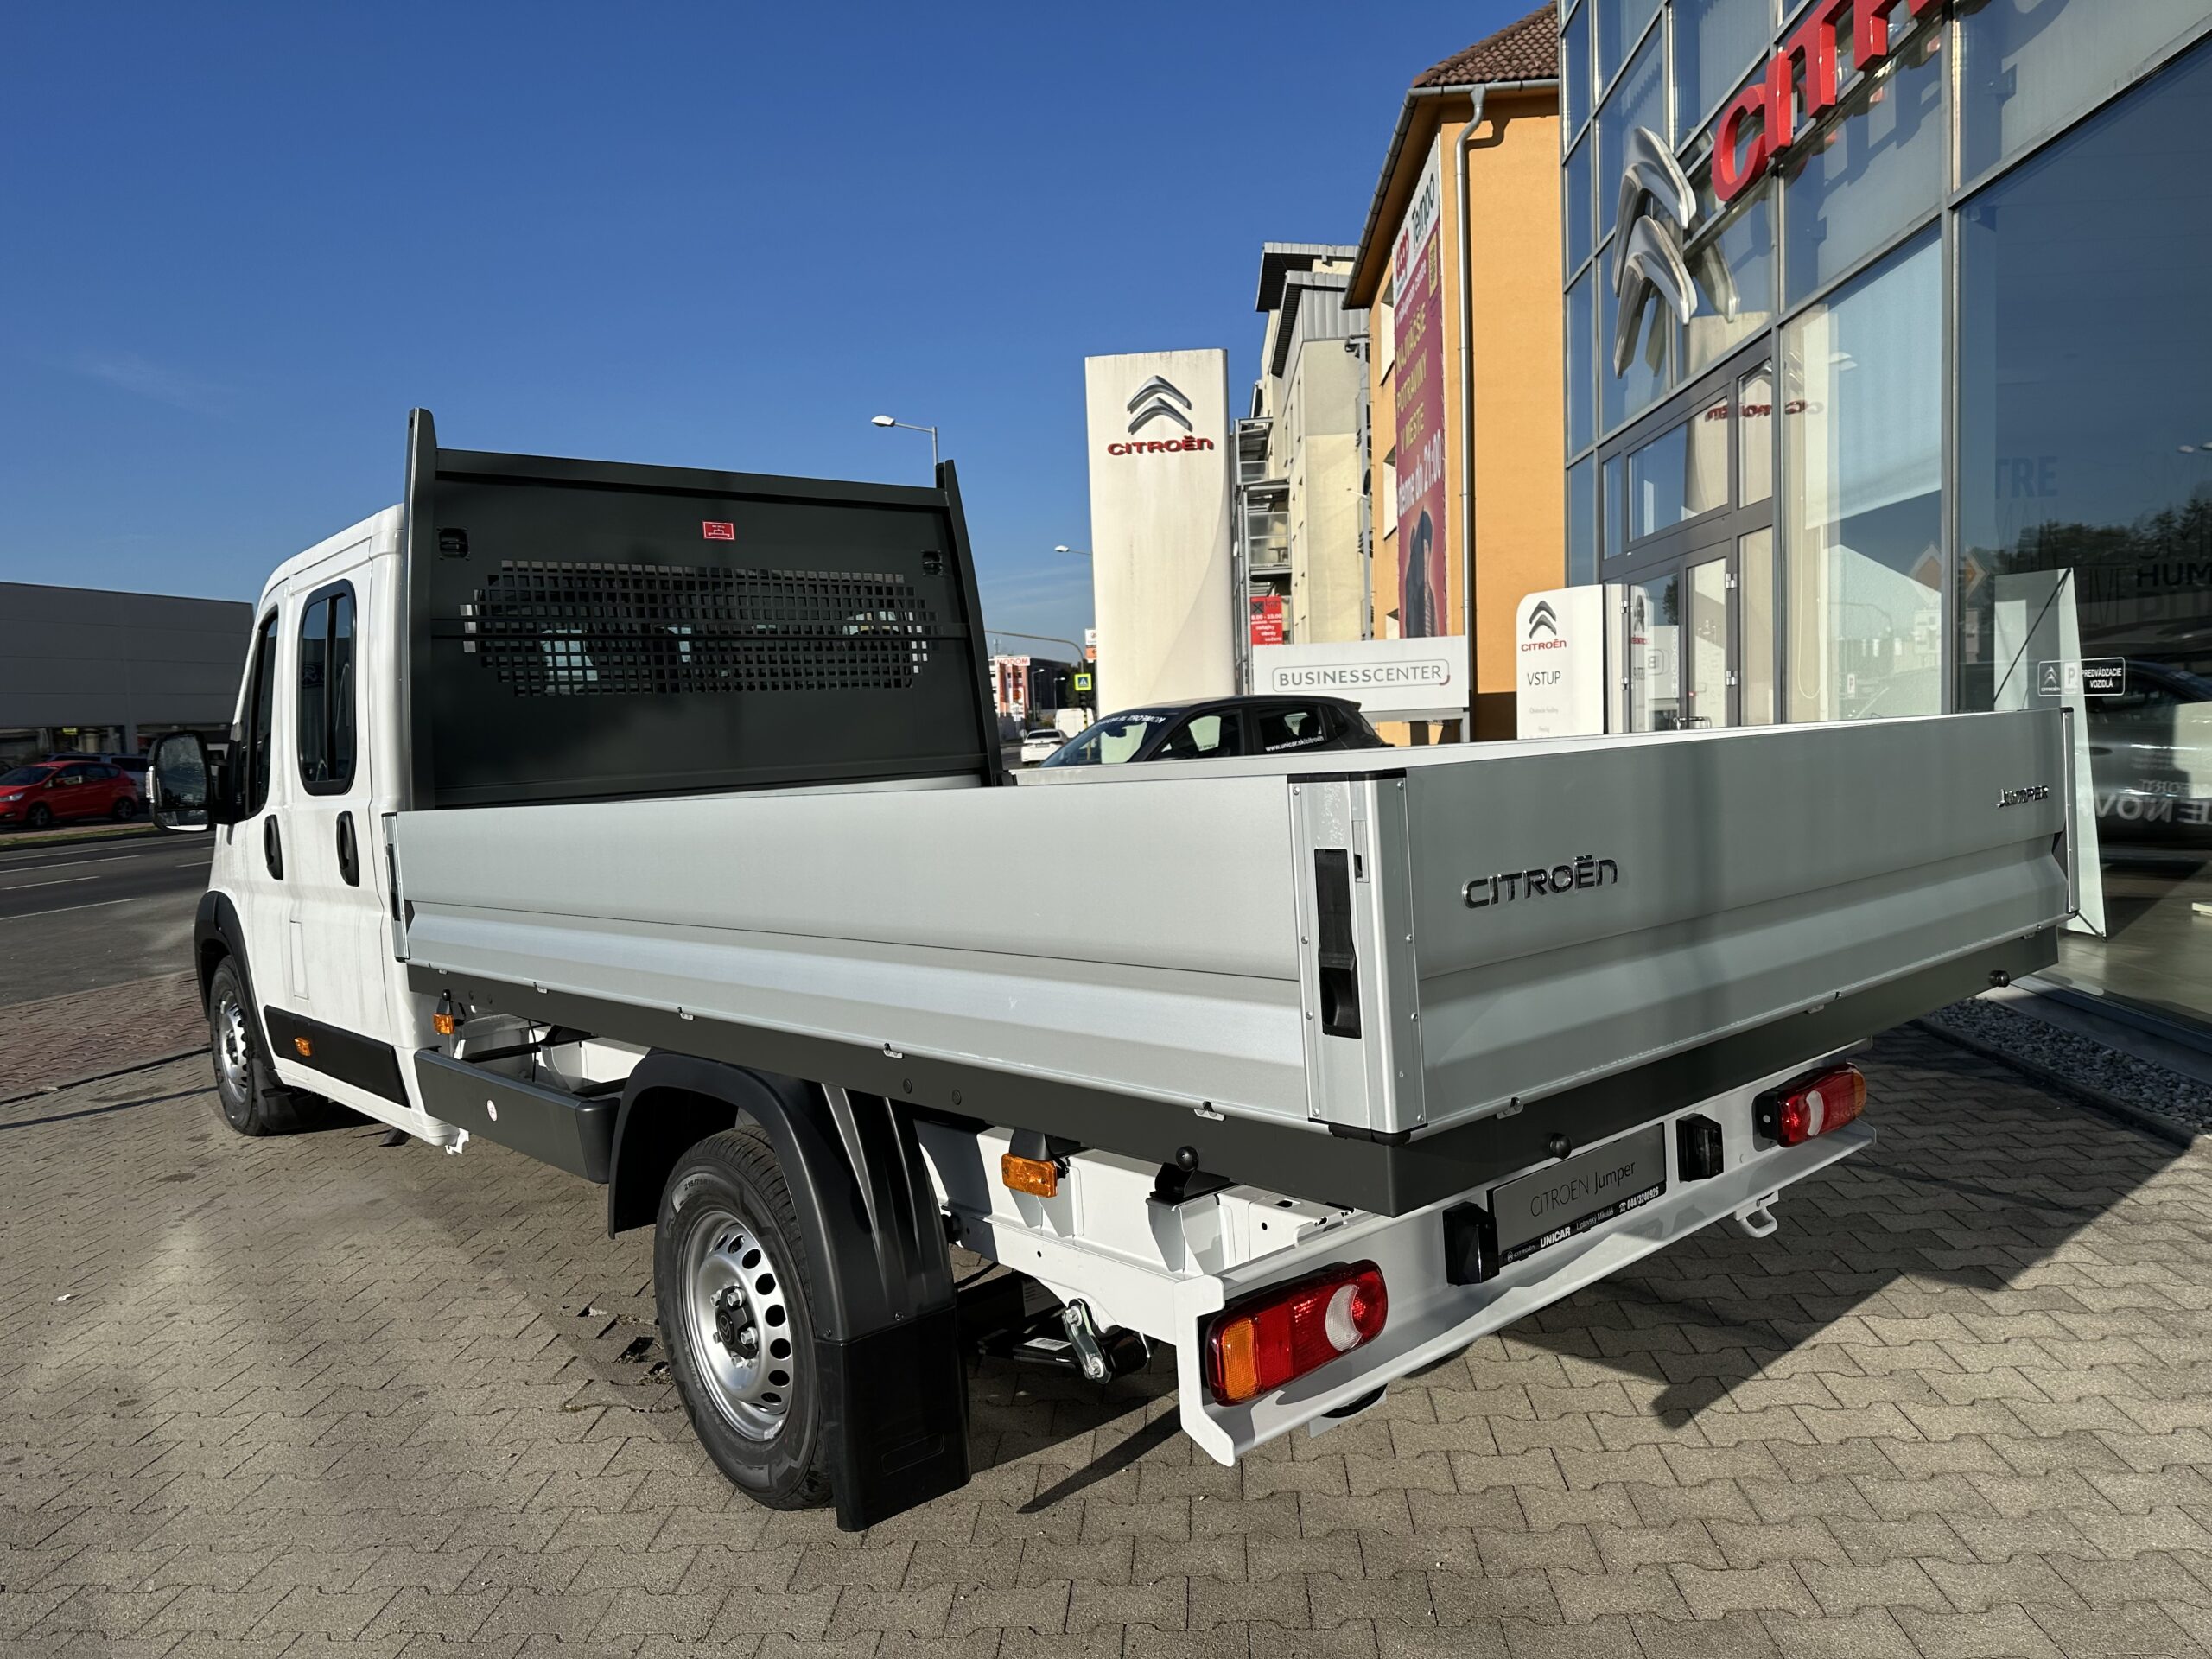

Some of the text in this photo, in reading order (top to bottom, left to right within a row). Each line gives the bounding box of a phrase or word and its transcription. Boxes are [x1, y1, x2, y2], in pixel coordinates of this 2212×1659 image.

[1279, 665, 1442, 687] BUSINESSCENTER
[1527, 671, 1561, 686] VSTUP
[2082, 667, 2122, 677] PREDVÁDZACIE
[2089, 678, 2113, 688] VOZIDLÁ
[1461, 855, 1618, 909] CITROËN
[1530, 1162, 1636, 1217] CITROËN Jumper
[1540, 1226, 1571, 1249] UNICAR
